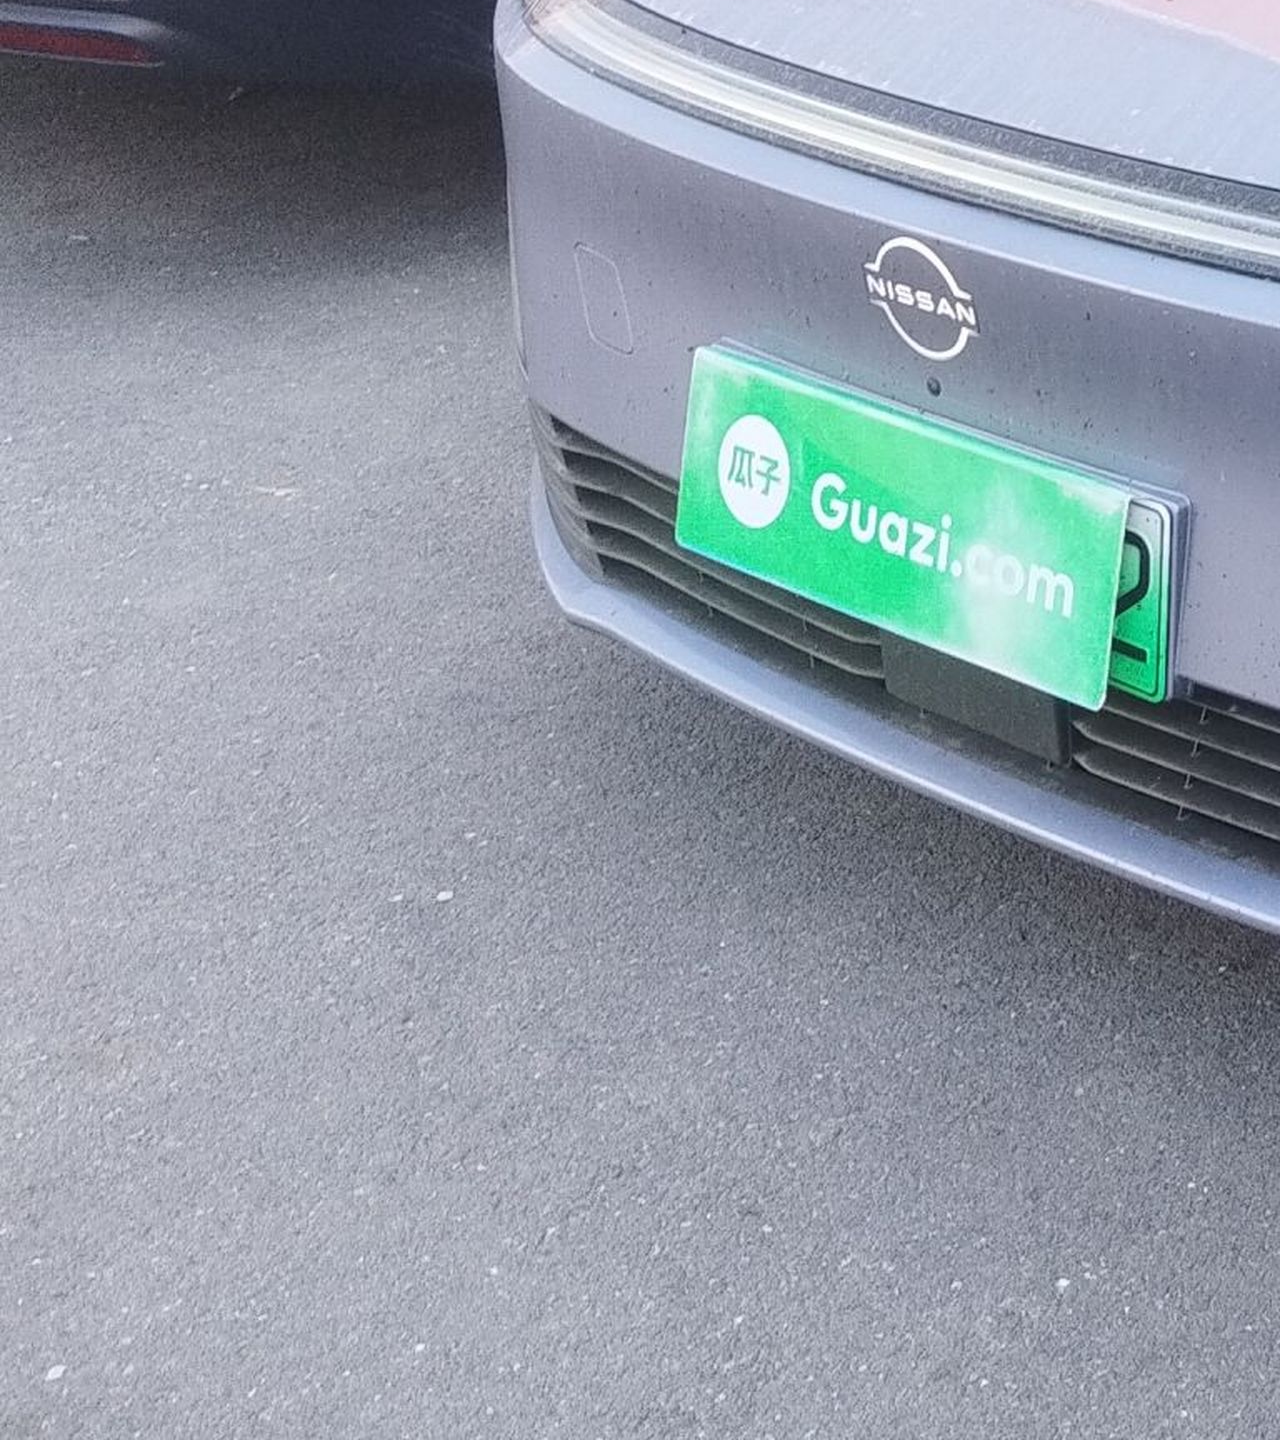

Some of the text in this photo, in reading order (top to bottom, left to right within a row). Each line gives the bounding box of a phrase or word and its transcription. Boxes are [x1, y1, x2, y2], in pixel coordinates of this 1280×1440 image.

[866, 273, 976, 326] NISSAN
[727, 445, 783, 497] 瓜子
[810, 471, 1076, 619] Guazi.com
